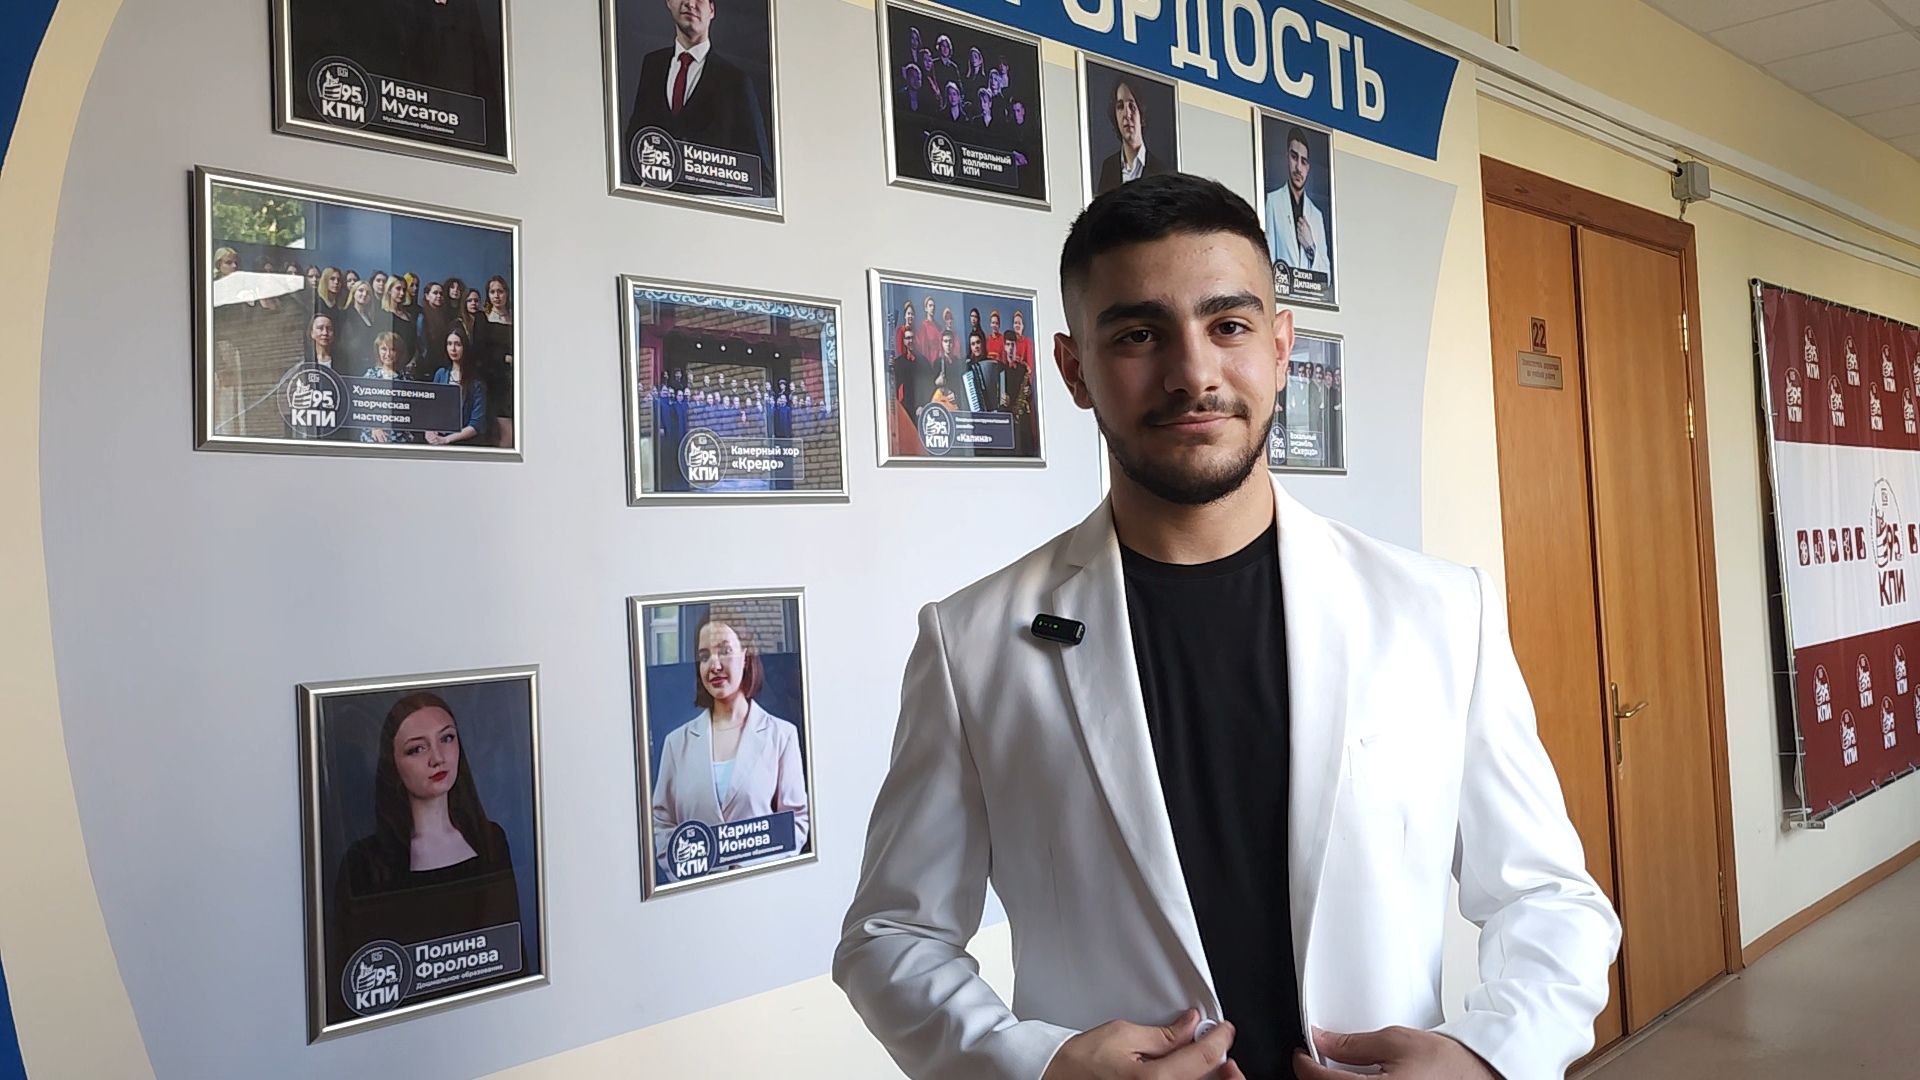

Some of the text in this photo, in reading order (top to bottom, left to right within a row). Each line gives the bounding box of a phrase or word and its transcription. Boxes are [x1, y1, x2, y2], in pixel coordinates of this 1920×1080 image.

[1010, 0, 1386, 121] РДОСТЬ
[381, 79, 428, 103] Иван
[322, 100, 366, 123] КПИ
[381, 97, 459, 126] Мусатов
[683, 145, 737, 167] Кирилл
[961, 147, 1012, 165] Театральный
[962, 158, 1003, 172] коллектив
[641, 164, 673, 183] КПИ
[684, 159, 749, 182] Бахнаков
[931, 162, 955, 177] КПИ
[963, 166, 981, 177] КПИ
[1275, 284, 1290, 295] КПИ
[1532, 322, 1547, 348] 22
[312, 390, 334, 408] 95
[352, 385, 435, 399] Художественная
[352, 400, 410, 410] творческая
[291, 408, 336, 427] КПИ
[352, 413, 411, 423] мастерская
[731, 445, 800, 457] Камерный хор
[925, 435, 949, 448] КПИ
[688, 466, 719, 481] КПИ
[731, 457, 784, 472] «Кредо»
[1878, 568, 1906, 607] КПИ
[718, 820, 770, 839] Карина
[718, 834, 771, 854] Ионова
[676, 860, 709, 877] КПИ
[415, 936, 487, 962] Полина
[415, 950, 499, 978] Фролова
[355, 984, 399, 1010] КПИ
